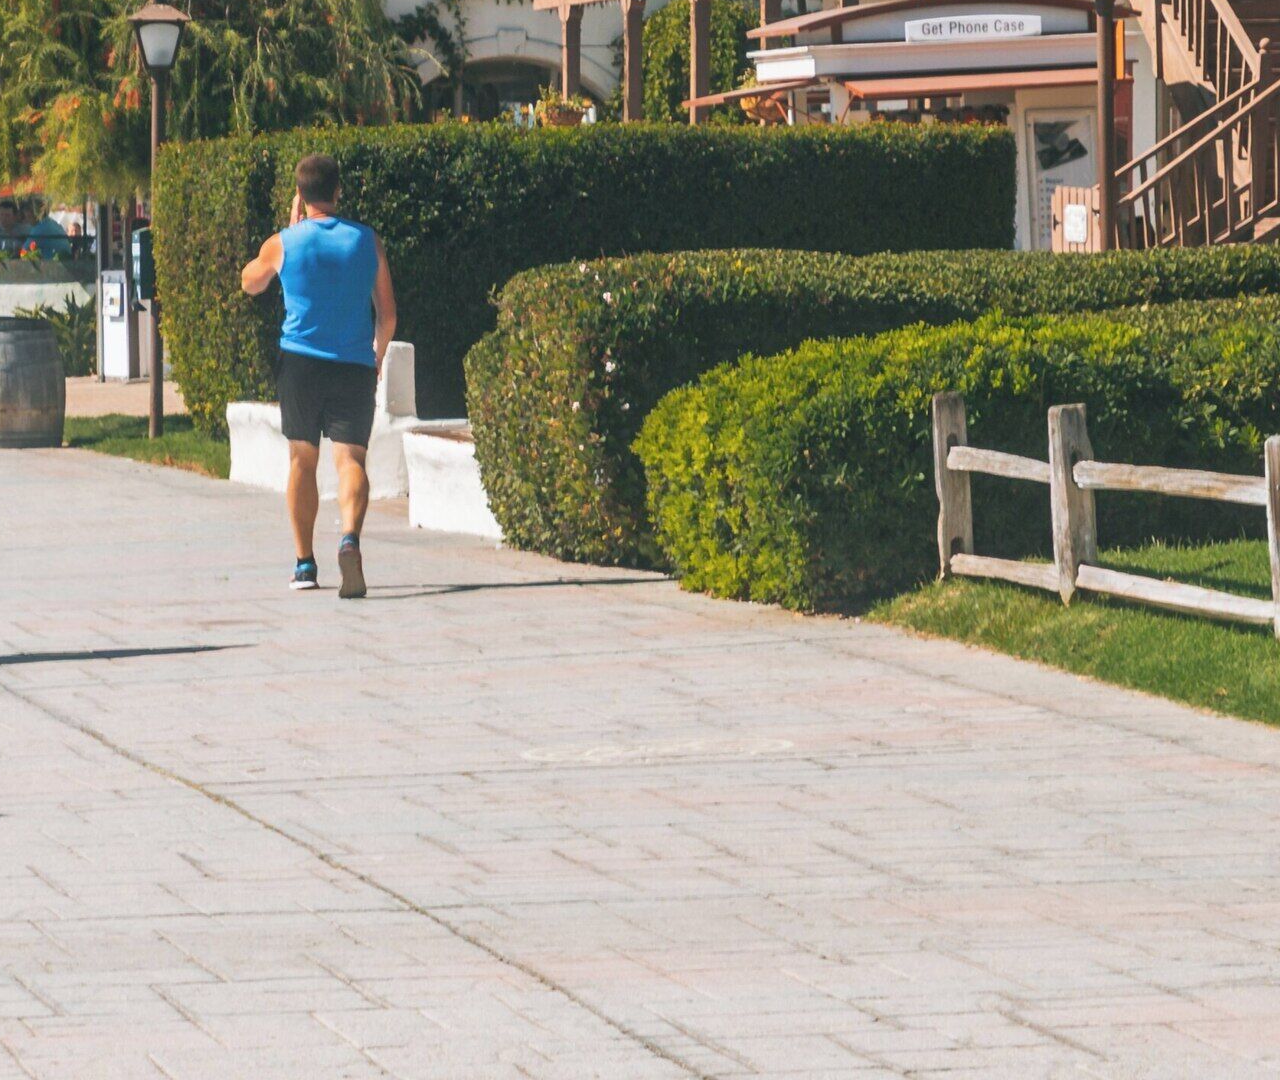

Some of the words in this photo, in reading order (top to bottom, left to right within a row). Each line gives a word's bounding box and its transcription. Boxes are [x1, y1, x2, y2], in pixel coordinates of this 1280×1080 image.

[922, 22, 942, 35] Get
[949, 21, 988, 34] Phone
[994, 19, 1024, 32] Case
